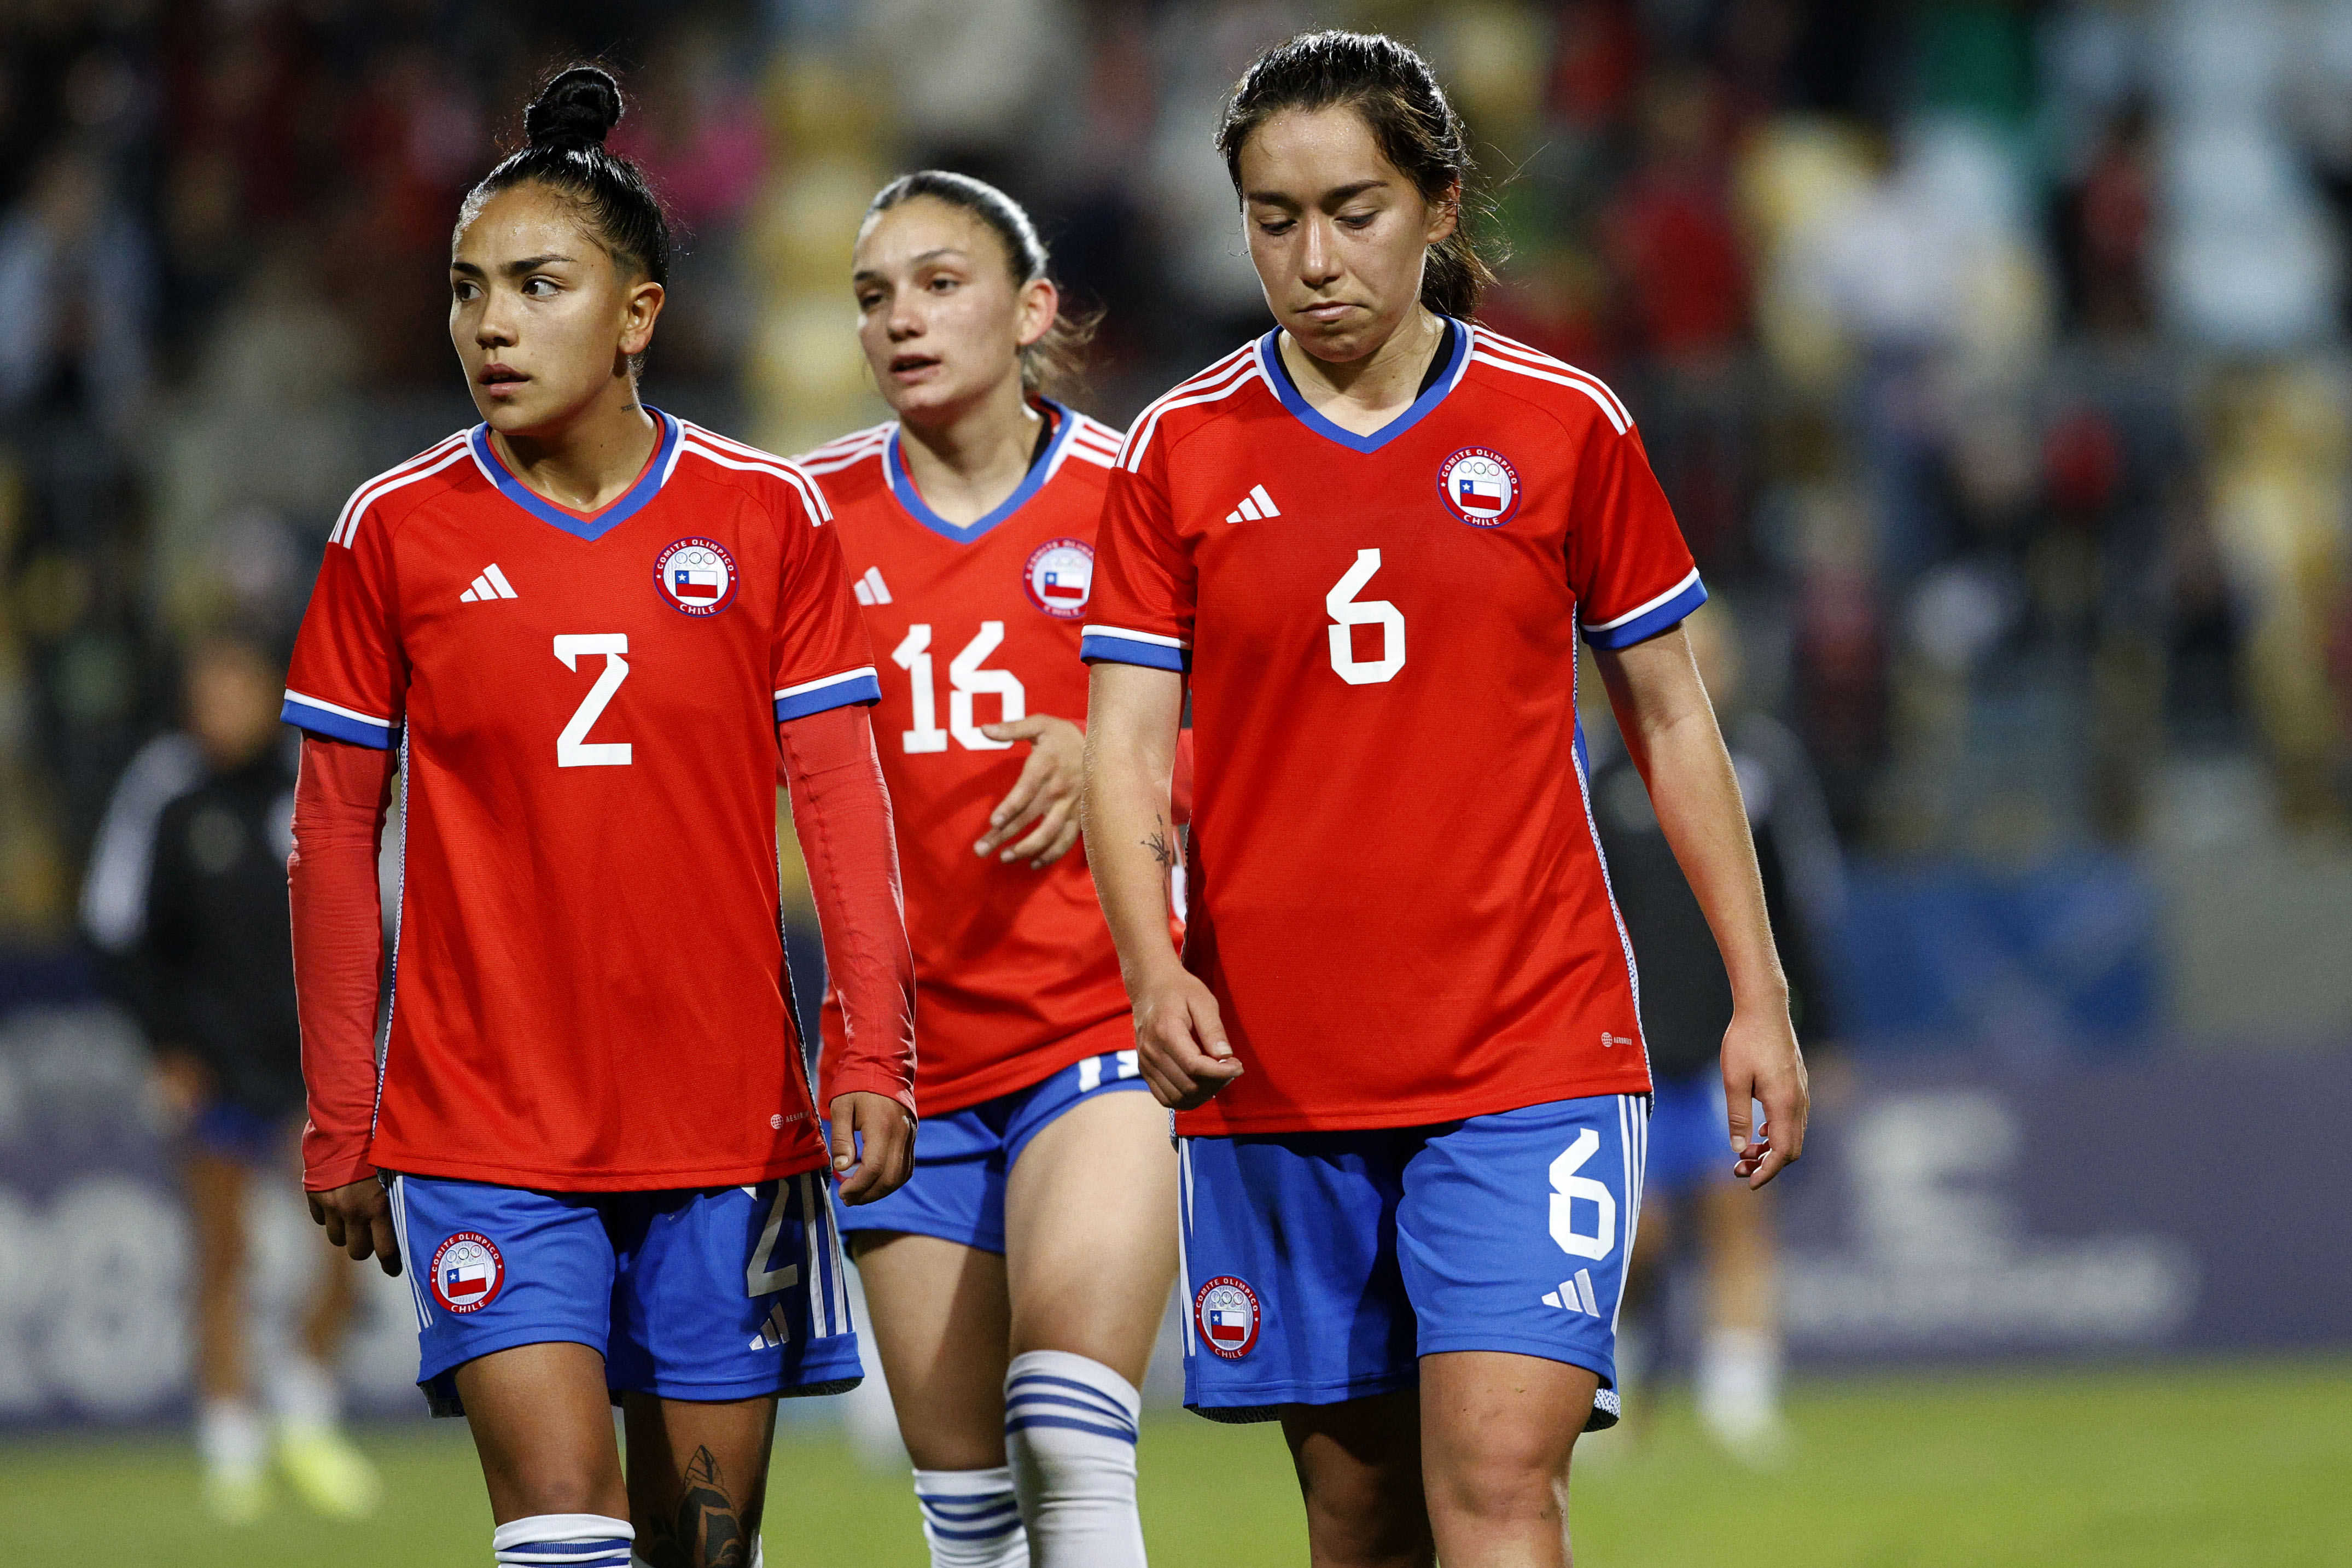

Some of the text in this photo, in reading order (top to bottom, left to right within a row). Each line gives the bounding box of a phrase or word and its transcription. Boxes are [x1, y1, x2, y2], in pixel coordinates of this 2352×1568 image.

[1441, 449, 1517, 484] COMITE OLIMPICO
[1463, 515, 1500, 526] CHILE
[657, 539, 734, 572] COMITE OLIMPICO
[679, 604, 715, 615] CHILE
[1326, 548, 1406, 685] 6
[554, 633, 632, 767] 2
[891, 621, 1025, 754] 16
[1549, 1128, 1616, 1261] 6
[432, 1234, 499, 1272] COMITE OLIMPICO
[740, 1179, 798, 1298] 2
[451, 1300, 485, 1313] CHILE
[1196, 1278, 1258, 1311] COMITE OLIMPICO
[1215, 1348, 1243, 1359] CHILE
